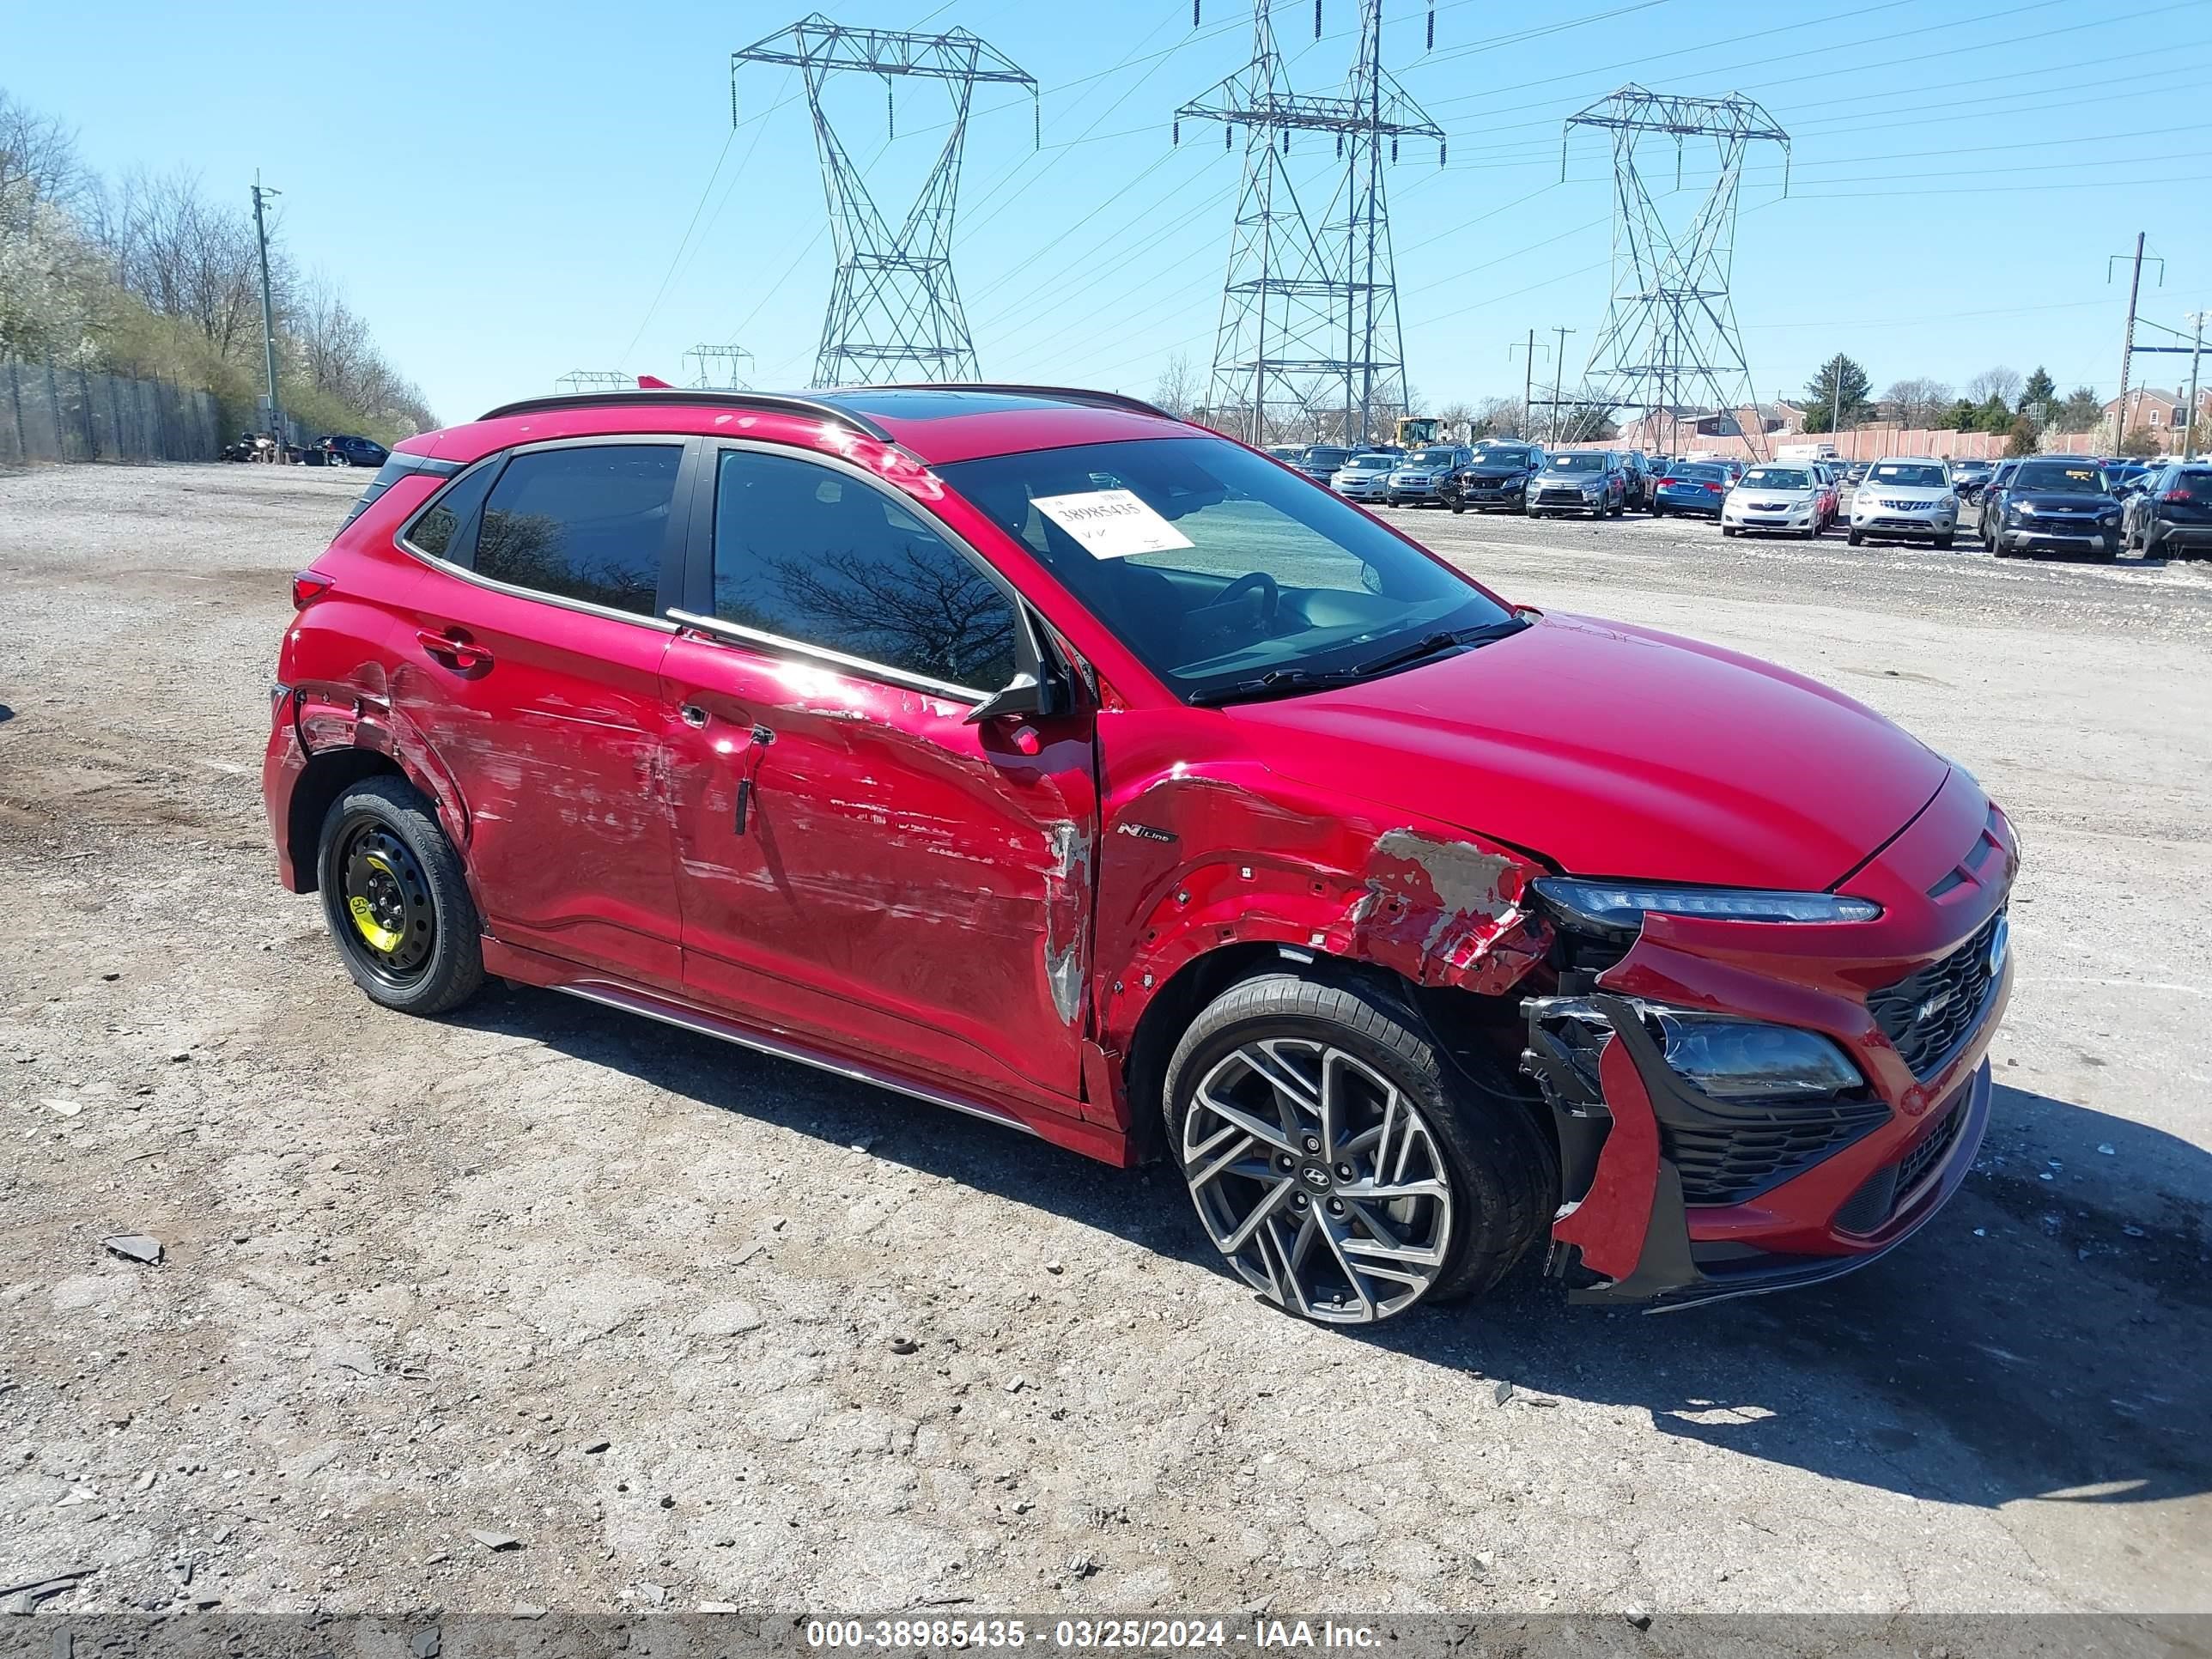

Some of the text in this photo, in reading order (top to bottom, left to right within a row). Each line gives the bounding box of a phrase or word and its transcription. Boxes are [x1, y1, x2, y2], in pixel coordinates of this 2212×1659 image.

[1058, 503, 1141, 522] 38985435
[1116, 822, 1142, 837] N
[352, 898, 367, 915] 50
